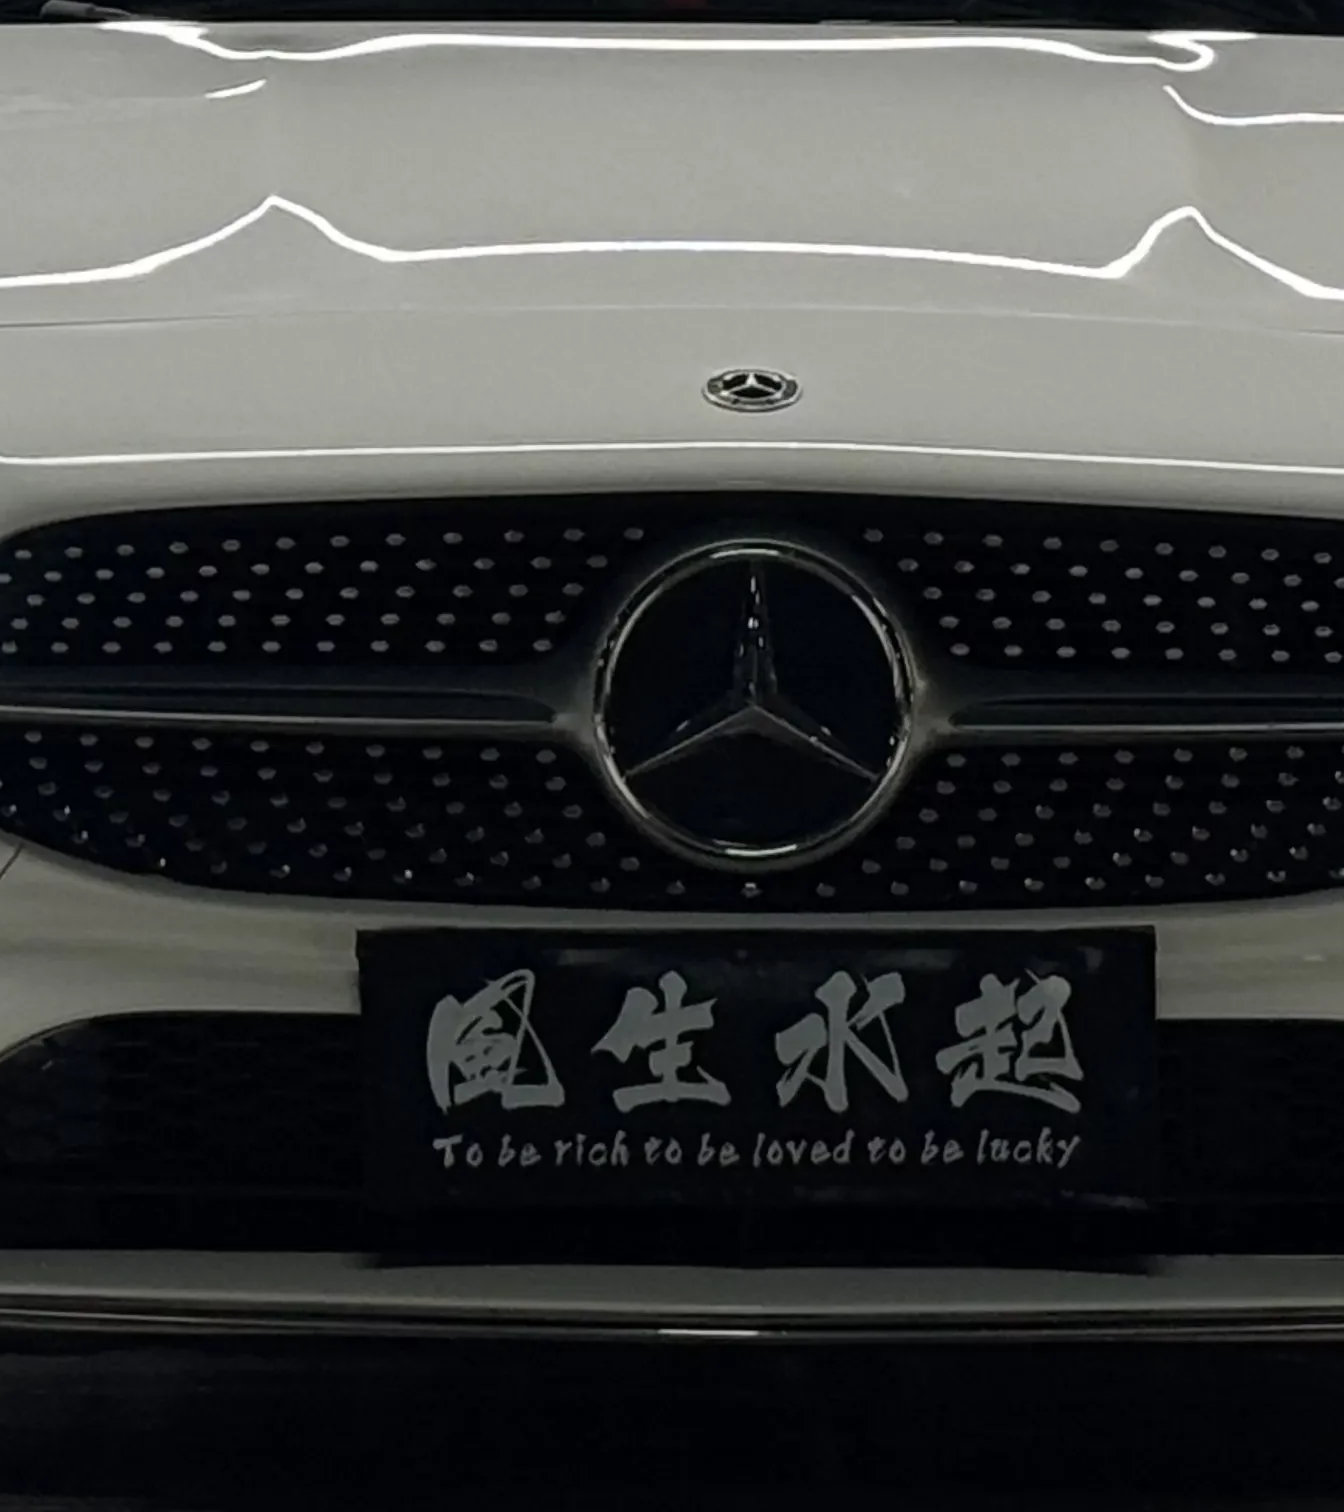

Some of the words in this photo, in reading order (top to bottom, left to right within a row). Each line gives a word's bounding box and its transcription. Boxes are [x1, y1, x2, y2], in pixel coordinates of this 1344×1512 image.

[432, 1134, 484, 1168] To
[497, 1133, 542, 1167] be
[554, 1129, 630, 1166] rich
[644, 1136, 683, 1165] to
[697, 1132, 740, 1166] be
[752, 1129, 855, 1168] loved
[867, 1136, 907, 1164] to
[920, 1129, 964, 1165] be
[976, 1126, 1081, 1169] lucky
